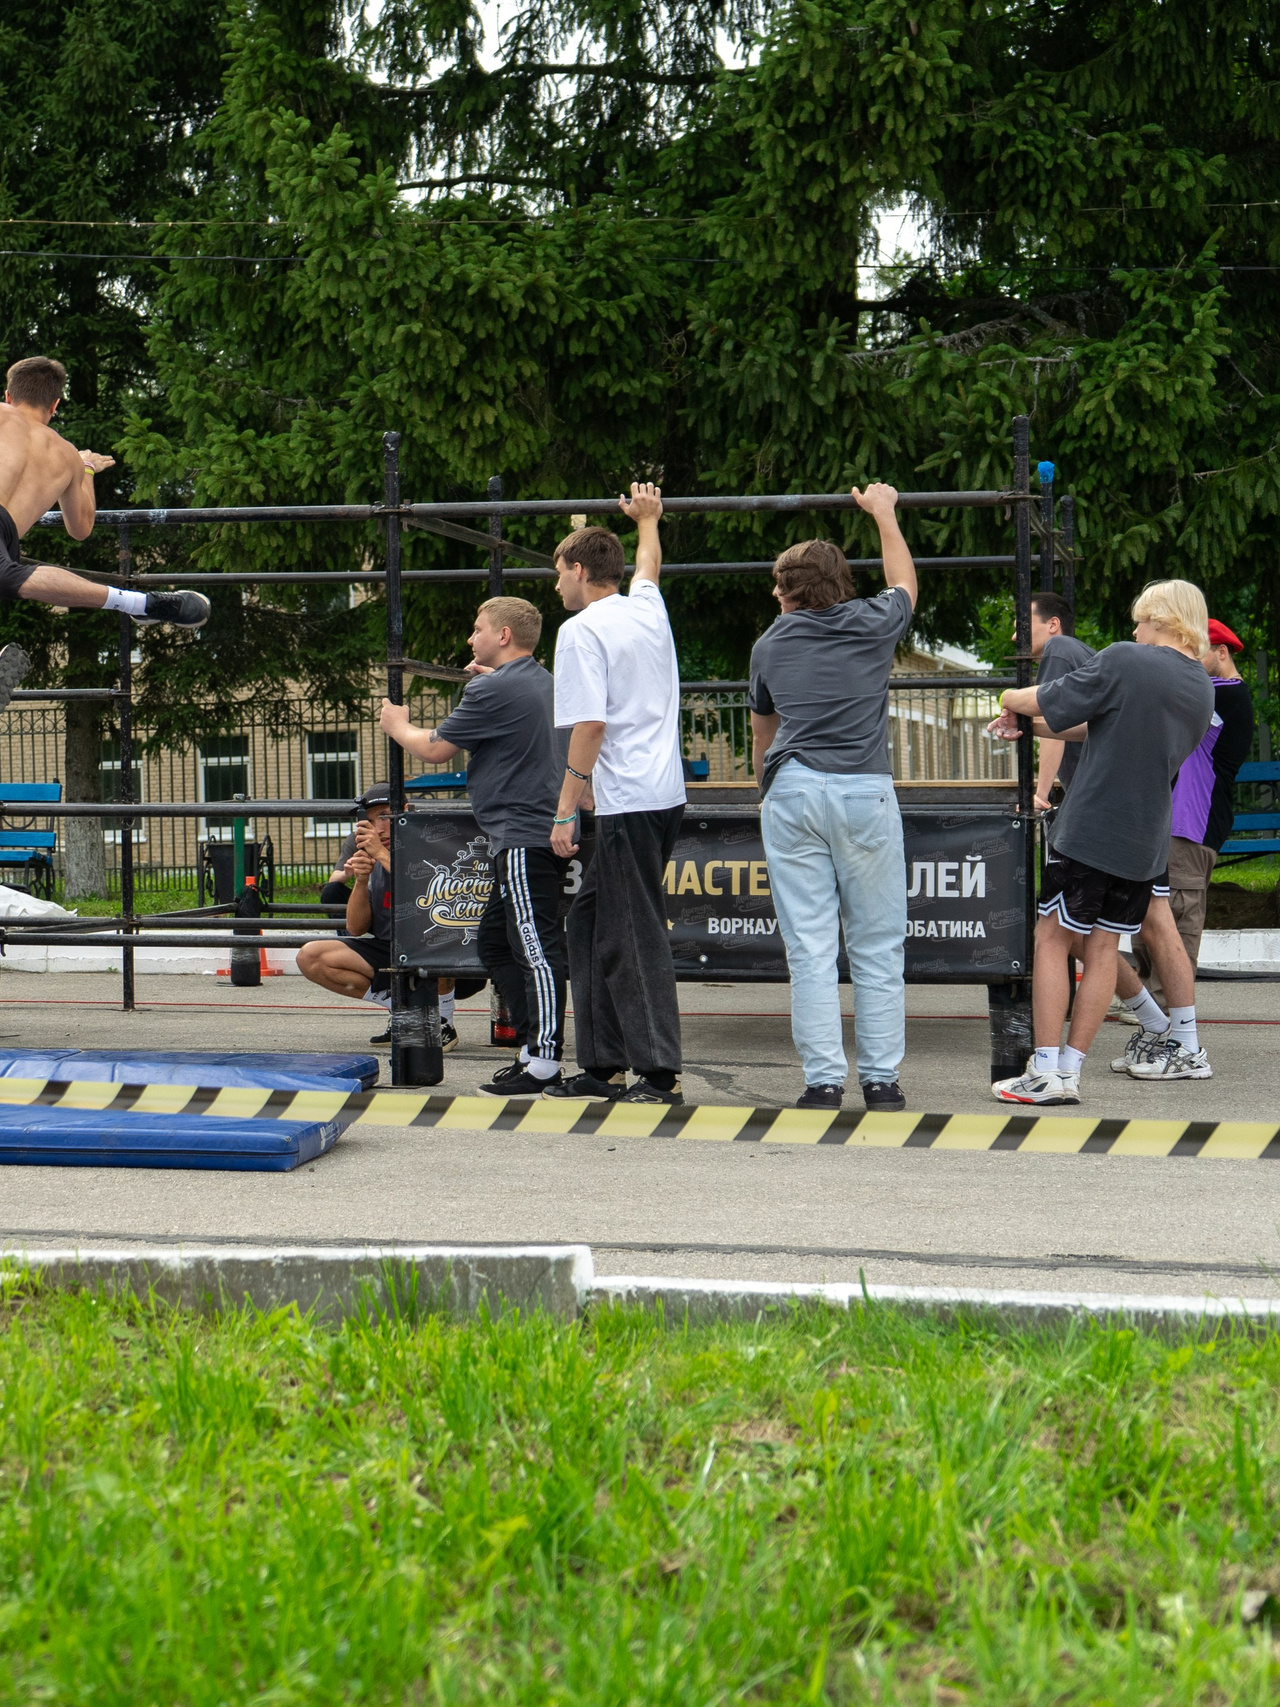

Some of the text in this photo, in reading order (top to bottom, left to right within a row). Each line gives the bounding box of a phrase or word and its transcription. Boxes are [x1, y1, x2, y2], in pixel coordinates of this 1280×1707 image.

[472, 859, 489, 871] Зал
[662, 854, 986, 898] МАСТЕ ЛЕЙ
[417, 871, 495, 908] Маст
[522, 926, 540, 963] adidas
[707, 917, 987, 938] ВОРКАУ ОБАТИКА
